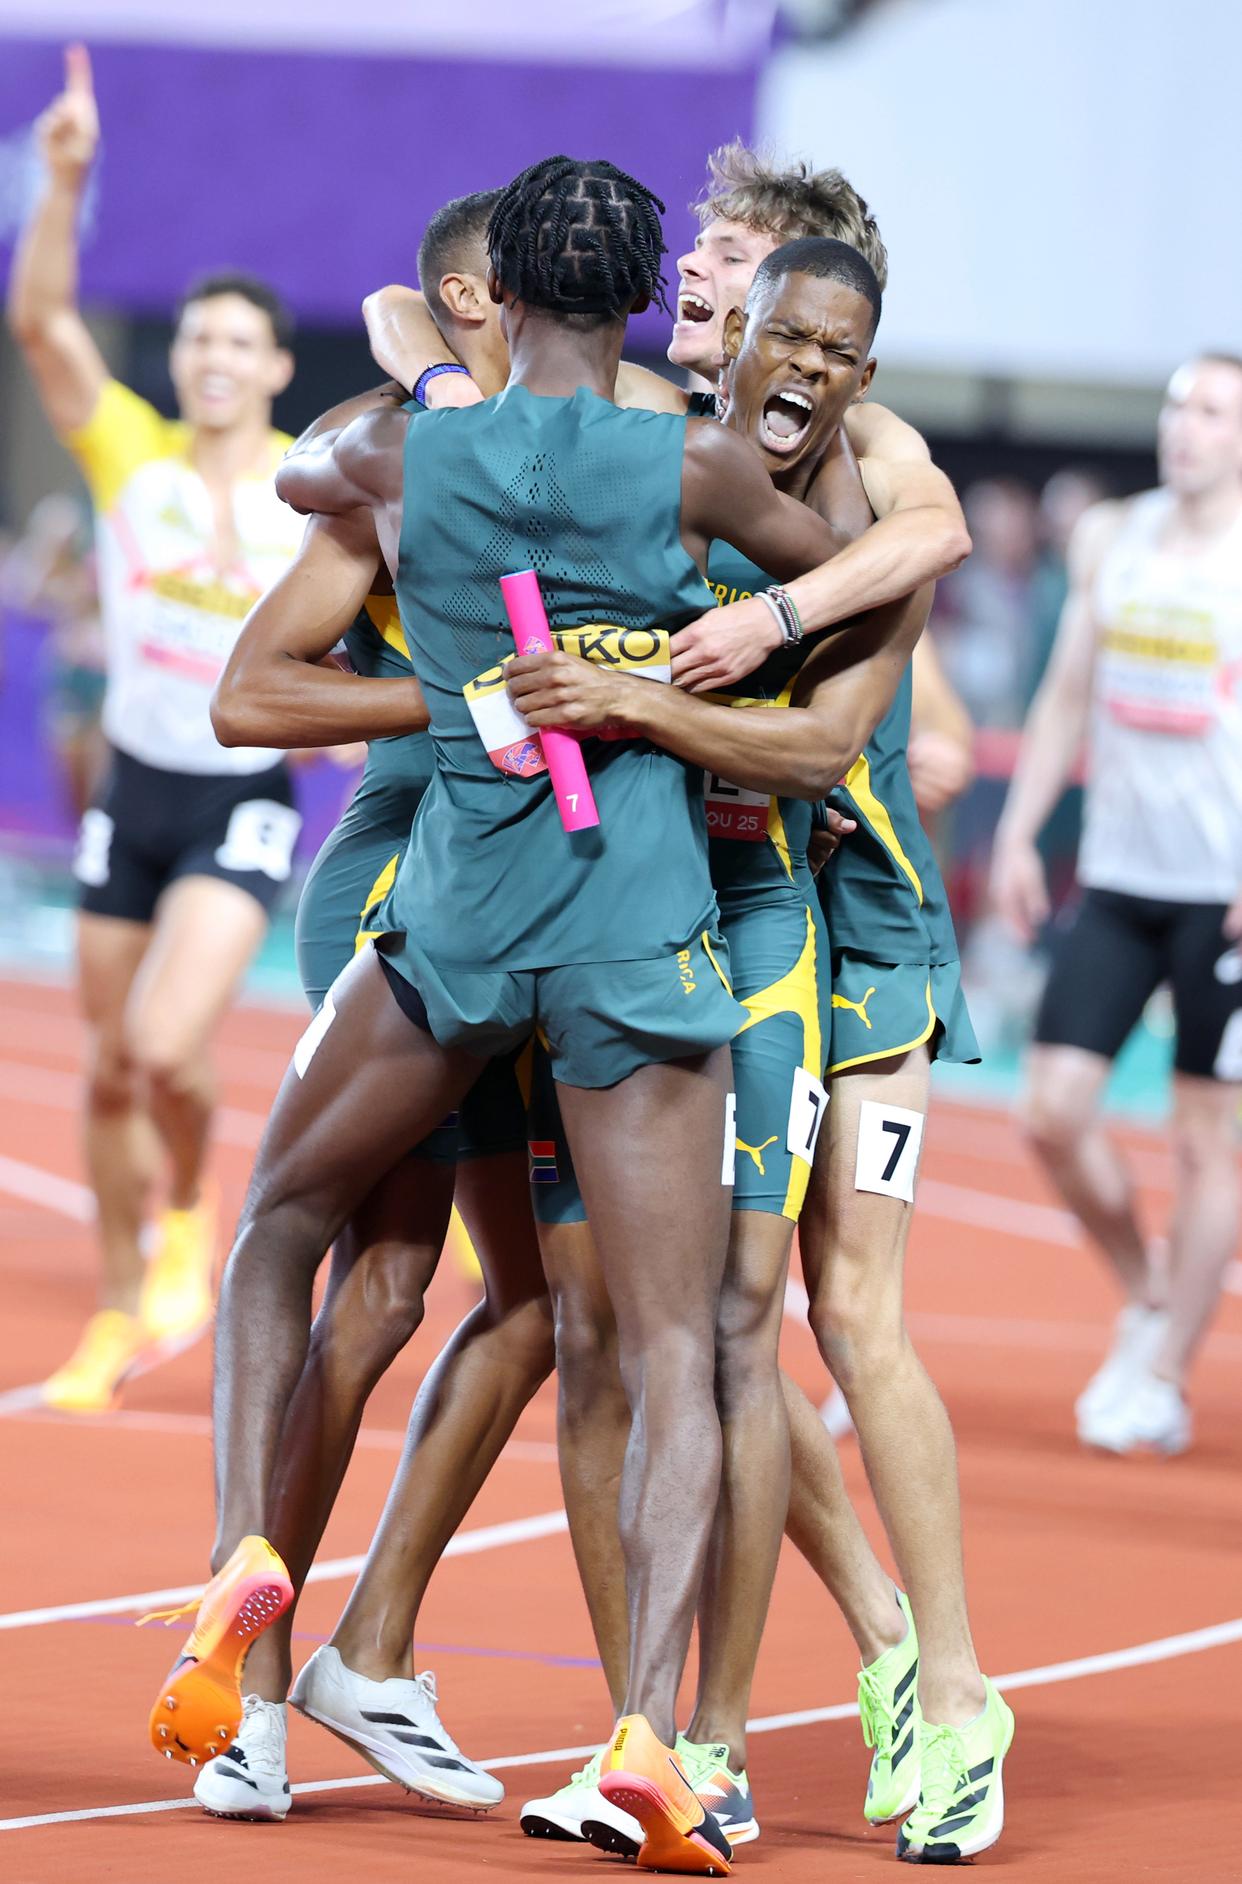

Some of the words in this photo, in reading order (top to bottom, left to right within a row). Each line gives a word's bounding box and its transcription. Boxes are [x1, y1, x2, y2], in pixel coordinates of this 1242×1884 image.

[566, 793, 579, 813] 7
[736, 815, 759, 831] 25
[805, 1090, 820, 1151] 7
[882, 1120, 911, 1181] 7
